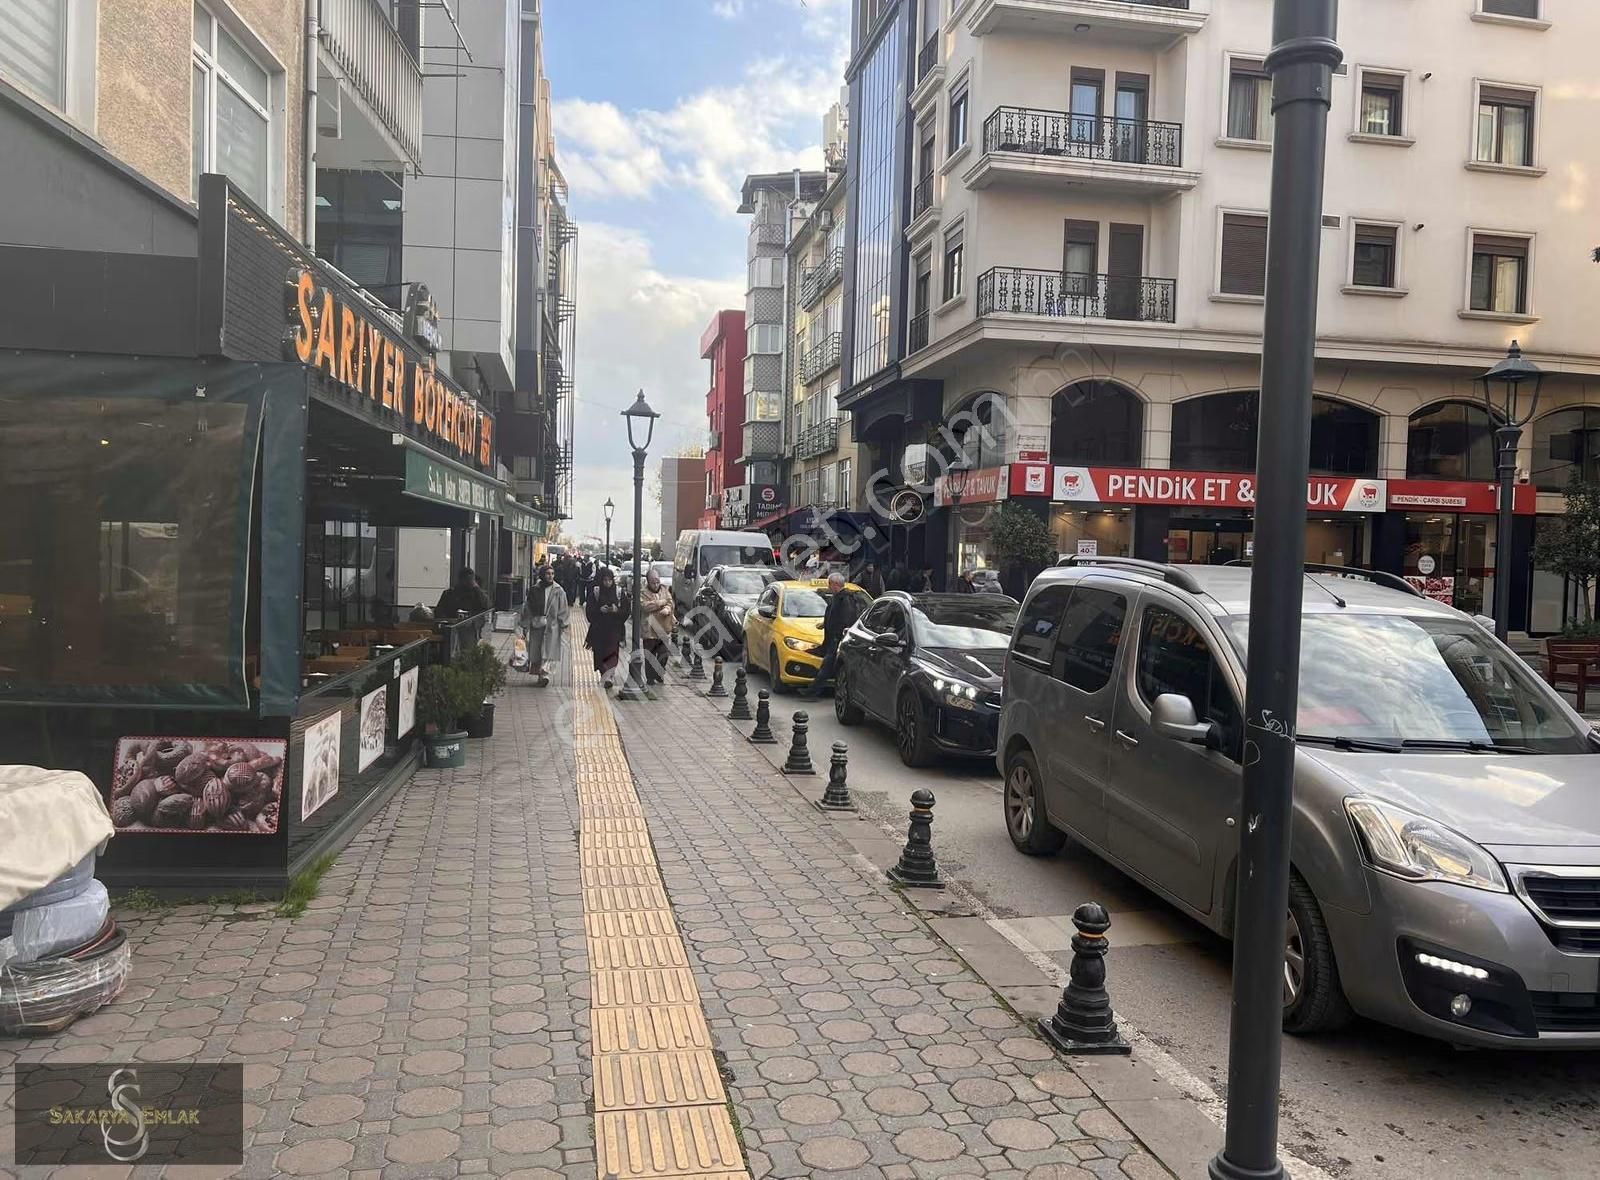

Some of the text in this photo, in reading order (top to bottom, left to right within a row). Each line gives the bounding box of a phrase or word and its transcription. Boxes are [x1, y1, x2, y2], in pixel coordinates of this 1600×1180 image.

[296, 267, 404, 416] SARIYER
[976, 475, 997, 496] TAVUK
[1203, 478, 1231, 501] ET
[1236, 477, 1256, 502] &
